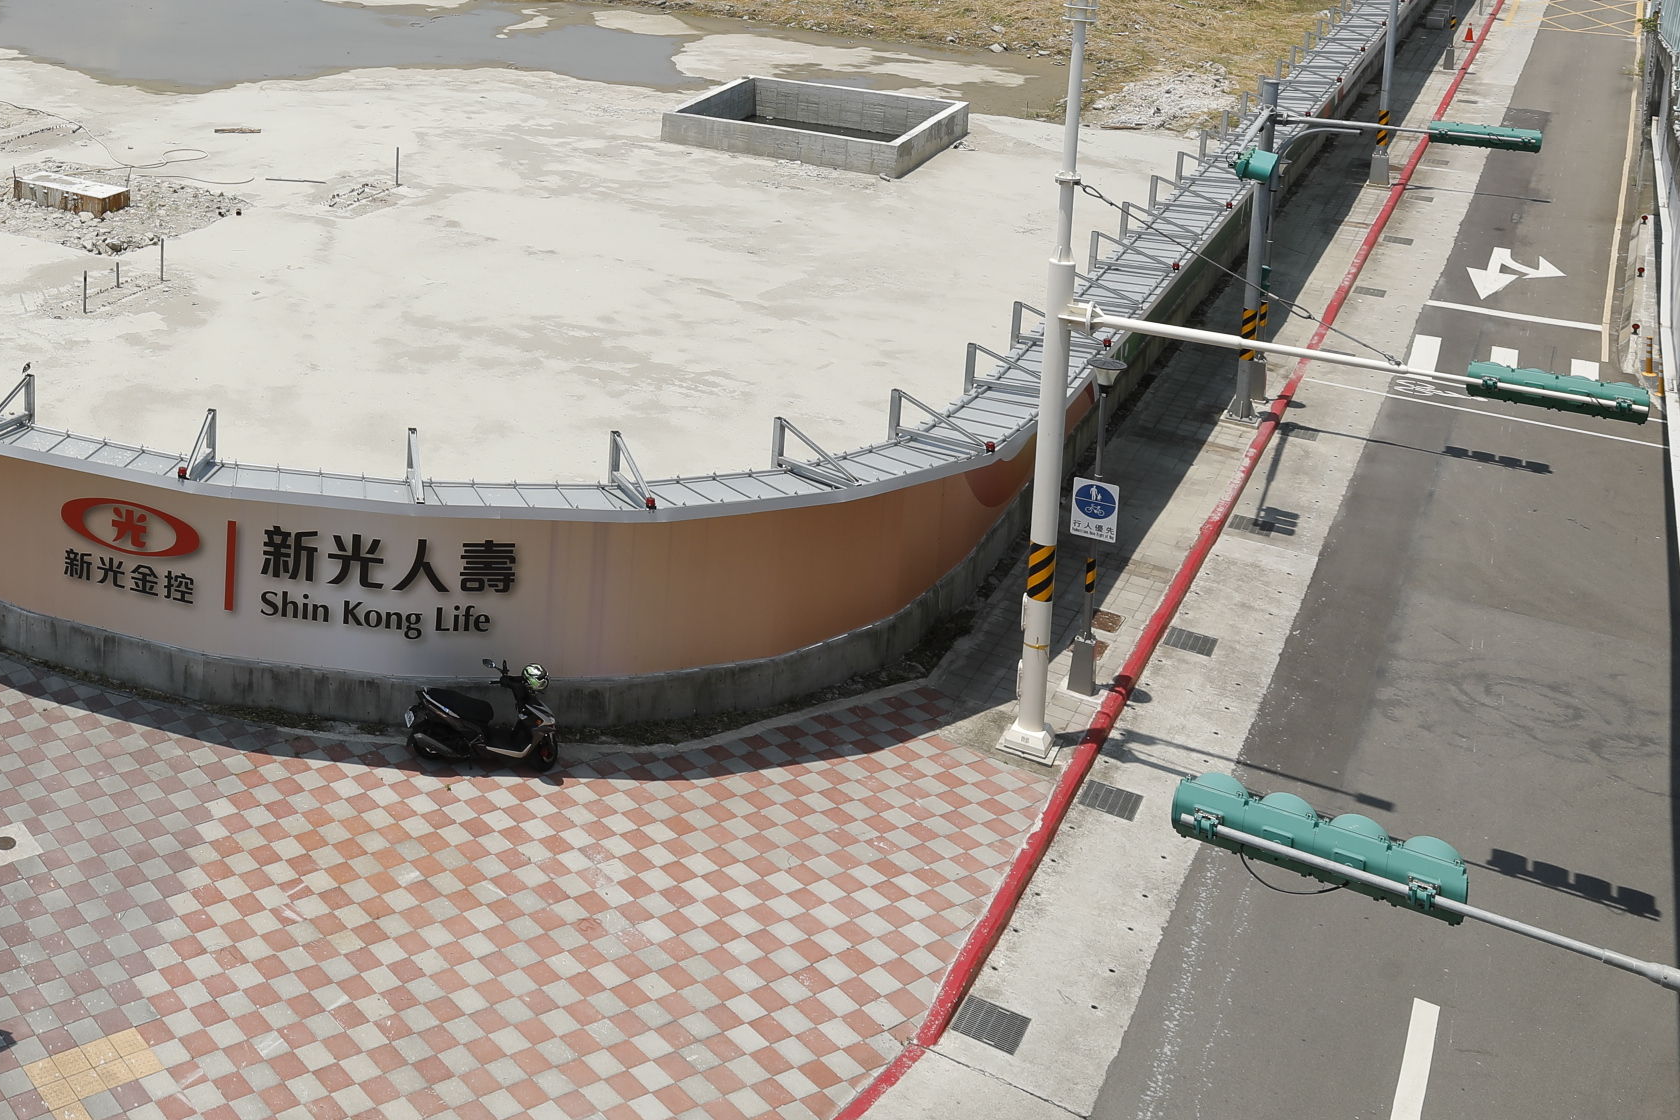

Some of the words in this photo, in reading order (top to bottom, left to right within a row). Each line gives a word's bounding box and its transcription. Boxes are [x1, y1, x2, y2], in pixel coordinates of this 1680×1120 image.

[112, 506, 148, 549] 光
[1072, 519, 1115, 536] 行人優先
[63, 548, 195, 605] 新光金控
[260, 525, 516, 594] 新光人壽
[260, 590, 330, 623] Shin
[343, 599, 423, 640] Kong
[435, 604, 491, 633] Life
